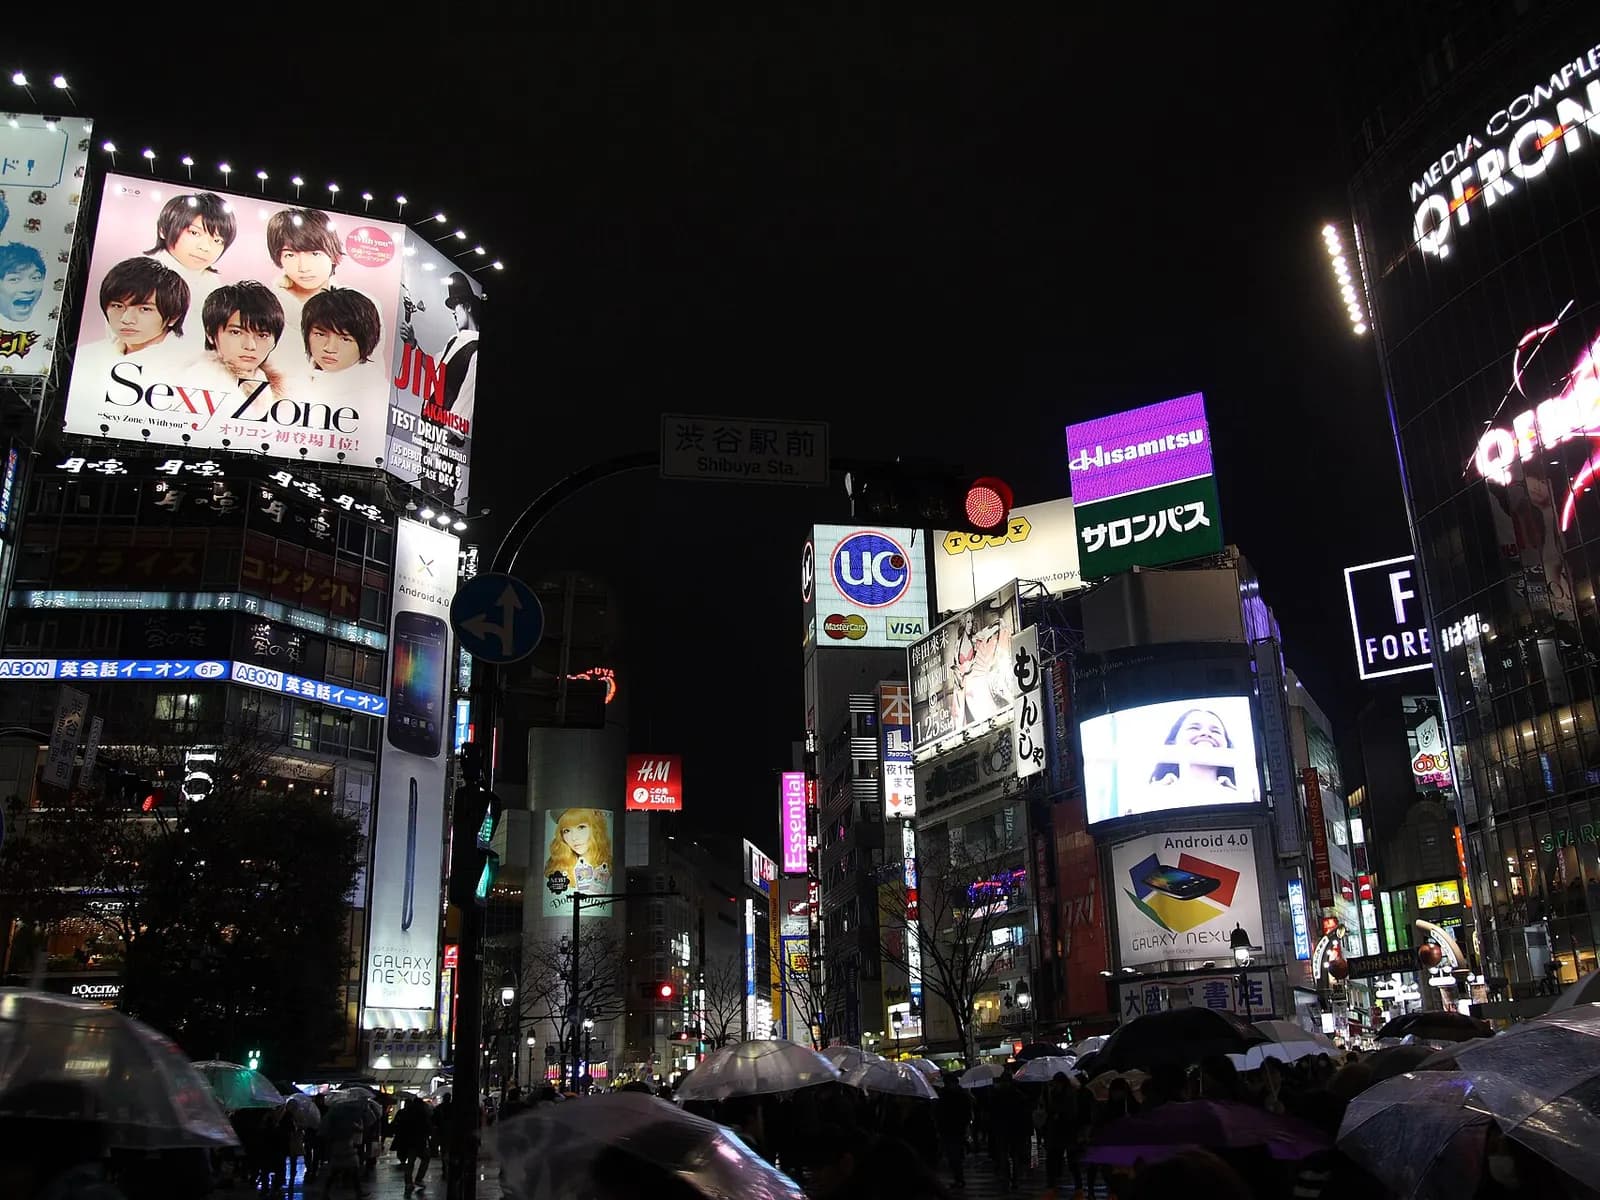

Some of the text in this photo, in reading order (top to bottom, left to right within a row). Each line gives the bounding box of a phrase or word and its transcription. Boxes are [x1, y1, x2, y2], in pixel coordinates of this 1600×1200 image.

[1409, 134, 1482, 202] MEDIA
[394, 342, 447, 406] JIN
[104, 362, 360, 433] Sexy Zone
[391, 407, 448, 446] TEST DRIVE
[675, 424, 815, 457] 渋谷駅前
[1069, 428, 1204, 471] Hisamitsu
[403, 447, 422, 463] DEBUT
[435, 460, 453, 474] NOV
[455, 463, 462, 478] 8
[698, 457, 799, 476] Shibuya Sta.
[438, 470, 455, 488] DEC
[456, 478, 463, 491] 7
[949, 524, 1023, 547] TOY
[1081, 501, 1210, 553] サロンパス
[840, 550, 903, 588] UC
[217, 597, 230, 607] 7F
[246, 599, 256, 609] 7F
[399, 584, 450, 607] Android 4.0
[1389, 570, 1414, 624] F
[825, 621, 867, 632] MasterCard
[890, 623, 923, 635] VISA
[1366, 628, 1431, 664] FORE
[60, 661, 190, 677] 英会話イーオン
[200, 665, 218, 675] 6F
[236, 665, 279, 688] AEON
[285, 676, 385, 711] 英会話イーオン
[1014, 646, 1044, 767] もんじゃ
[637, 760, 671, 783] H&M
[650, 794, 676, 804] 150m
[785, 773, 802, 870] Essential
[1164, 833, 1249, 850] Android 4.0
[1132, 929, 1232, 951] GALAXY NEXU
[373, 954, 432, 969] GALAXY
[1124, 979, 1264, 1017] 大盛書店
